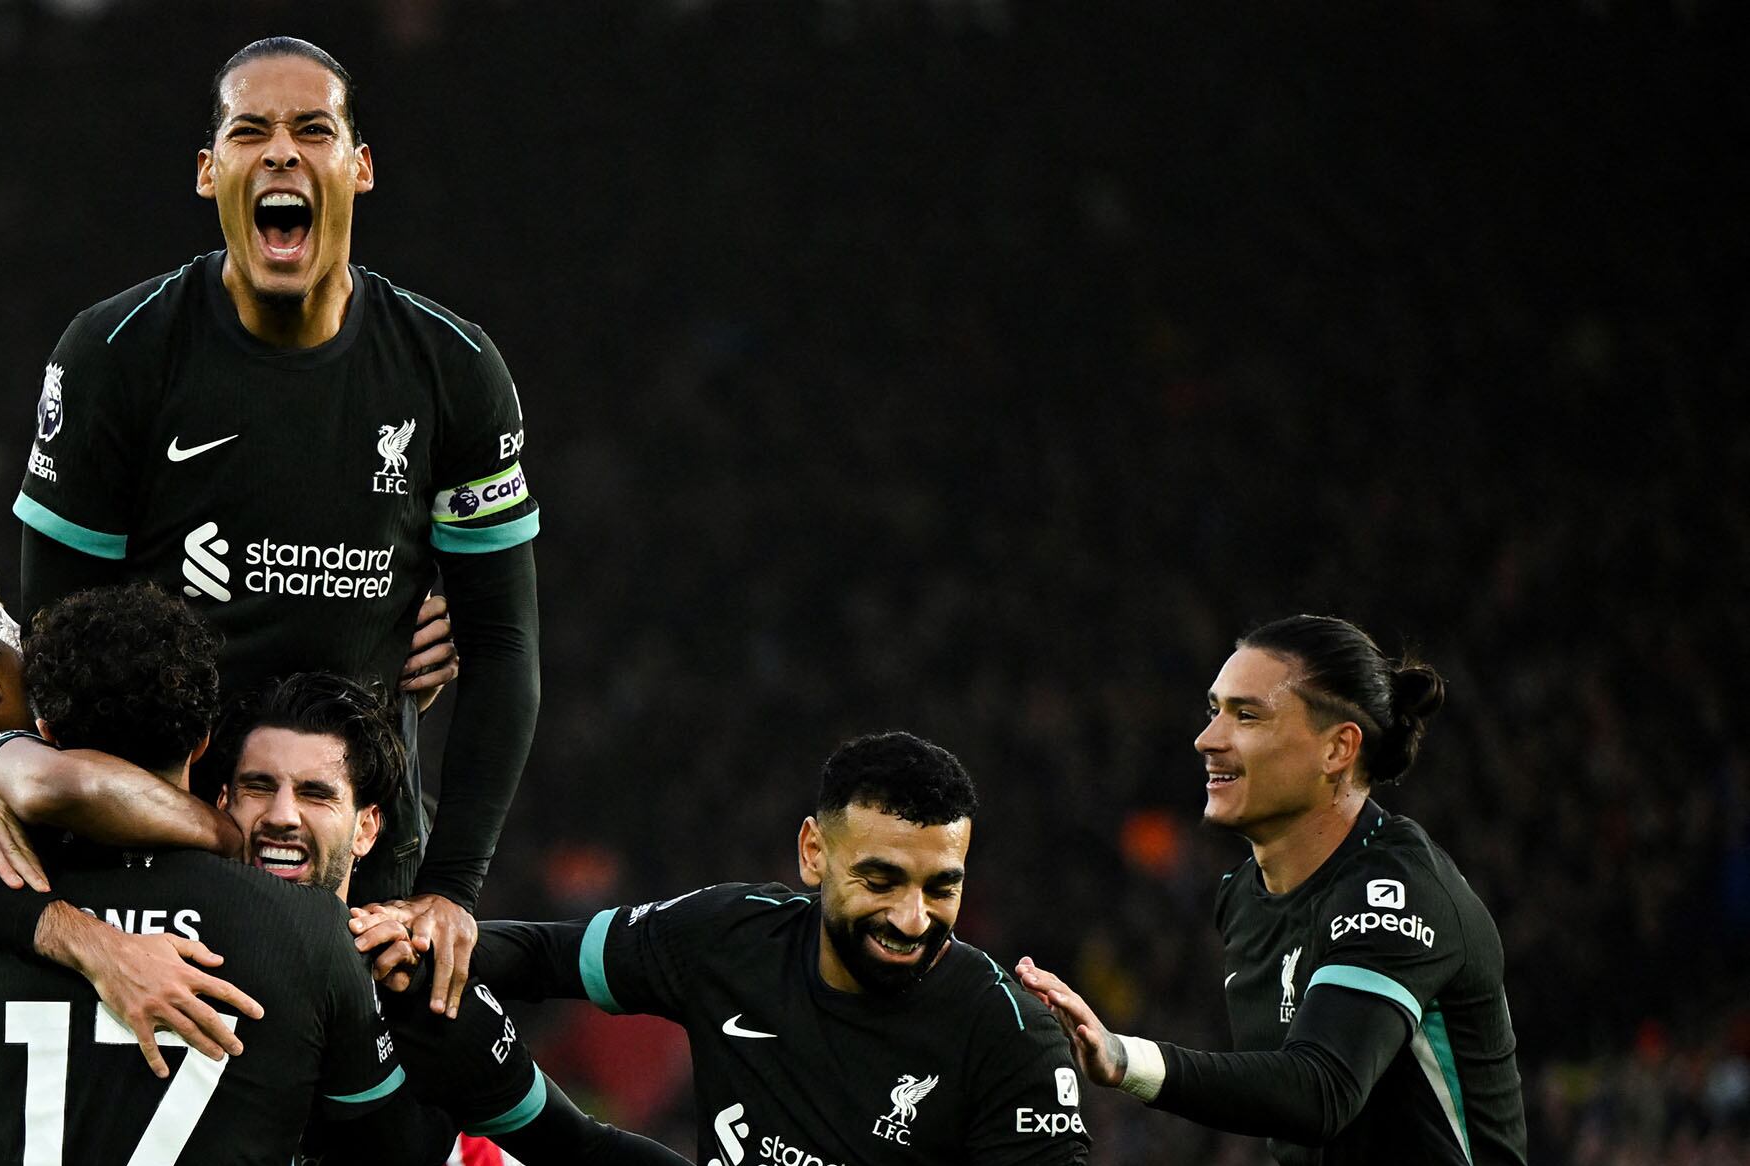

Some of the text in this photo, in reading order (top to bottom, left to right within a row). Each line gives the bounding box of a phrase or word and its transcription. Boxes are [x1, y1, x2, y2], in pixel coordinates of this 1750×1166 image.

[245, 537, 395, 572] standard
[245, 565, 393, 599] chartered
[79, 906, 202, 942] NES
[1330, 911, 1435, 949] Expedia
